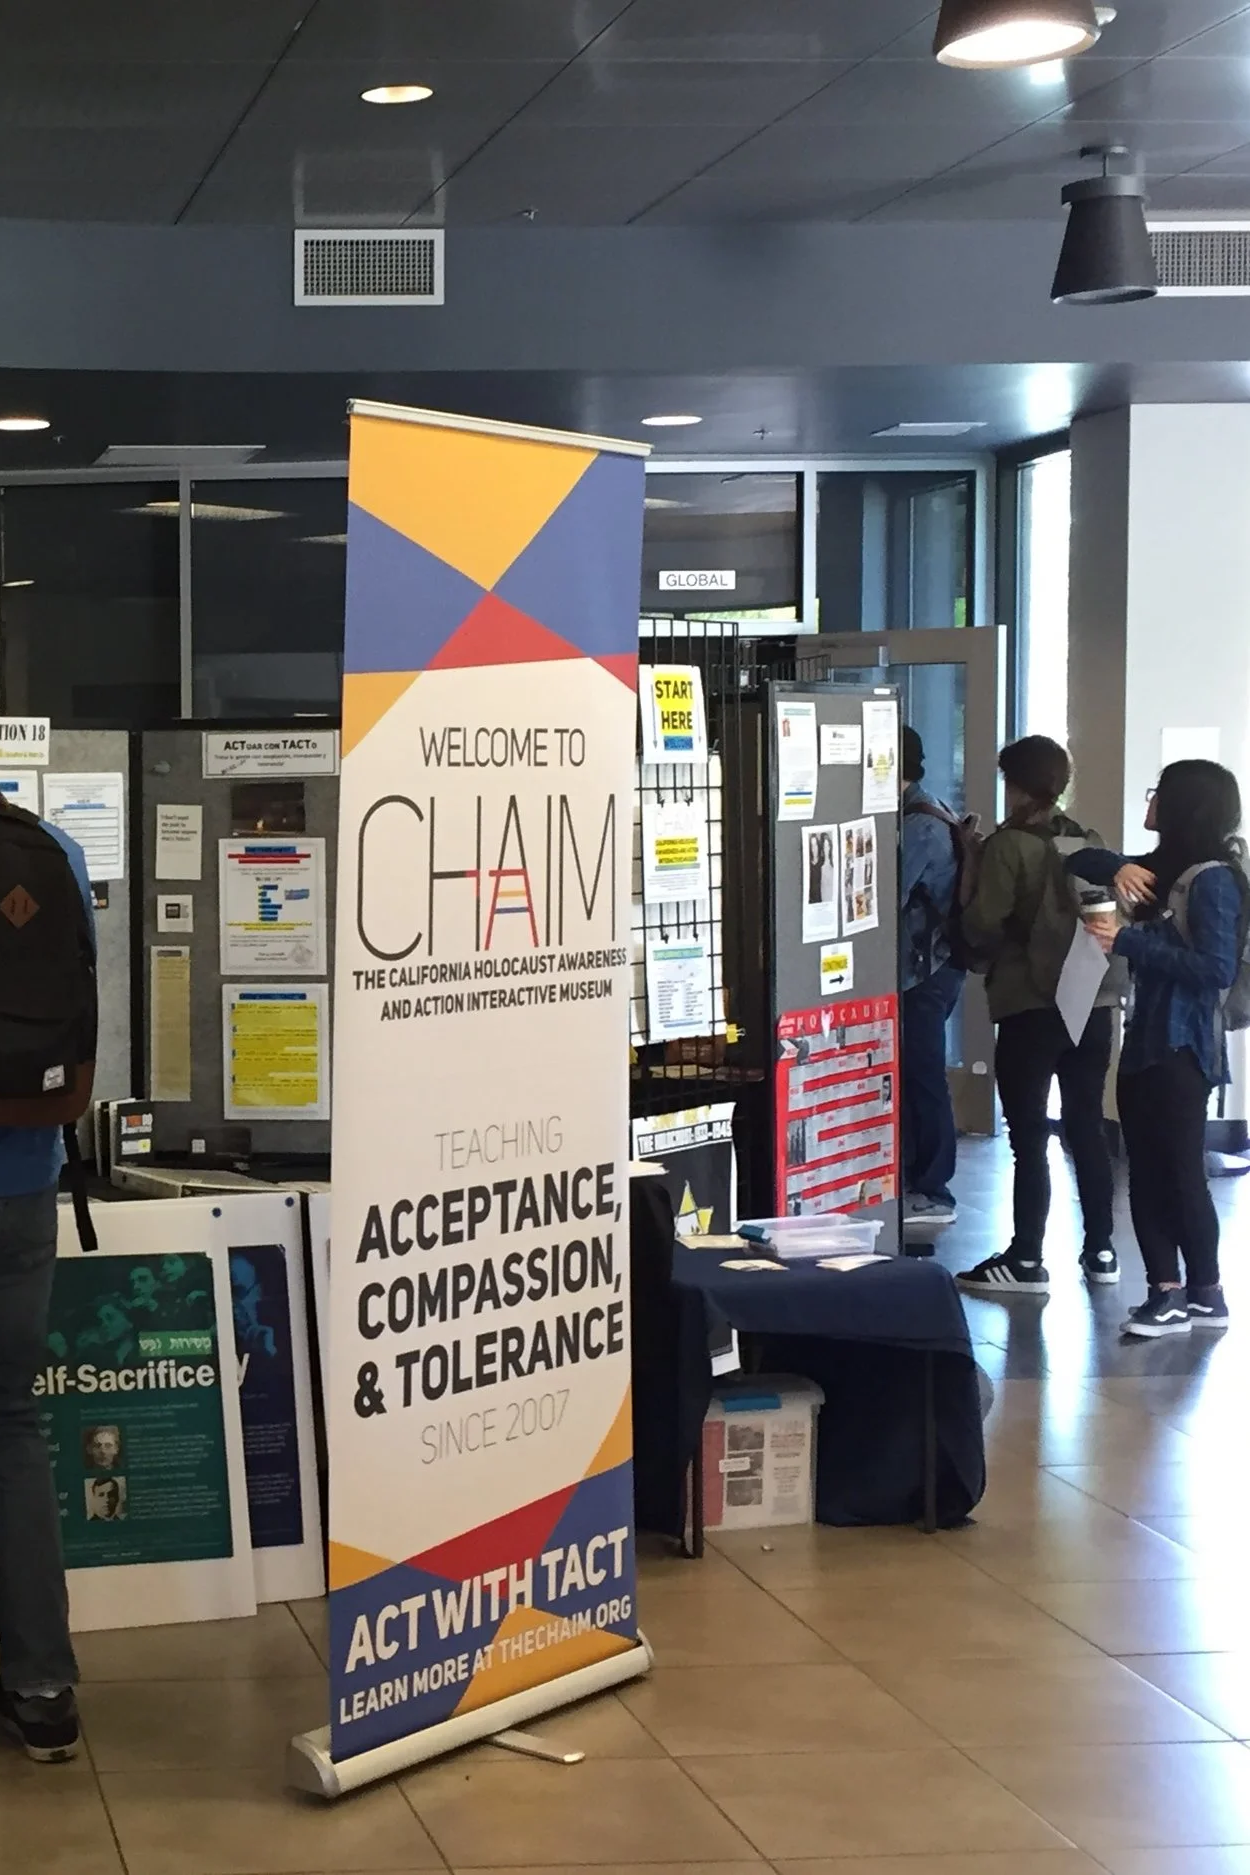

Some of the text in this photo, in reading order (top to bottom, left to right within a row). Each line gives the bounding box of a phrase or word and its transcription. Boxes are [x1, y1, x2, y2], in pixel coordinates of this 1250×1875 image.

[665, 574, 728, 587] GLOBAL
[654, 680, 693, 699] START
[32, 724, 46, 741] 18
[661, 710, 693, 730] HERE
[419, 727, 586, 768] WELCOME TO
[357, 793, 617, 962] CHAIM
[352, 947, 627, 991] THE CALIFORNIA HOLOCAUST AWARENESS
[380, 979, 613, 1021] AND ACTION INTERACTIVE MUSEUM
[435, 1115, 563, 1171] TEACHING
[355, 1161, 622, 1264] ACCEPTANCE,
[357, 1232, 622, 1340] COMPASSION,
[31, 1359, 215, 1396] elf-Sacrifice
[353, 1300, 624, 1419] & TOLERANCE
[421, 1389, 571, 1465] SINCE 2007
[344, 1526, 629, 1675] ACT WITH TACT
[339, 1594, 632, 1725] LEARN MORE AT THECHAIM.ORG
